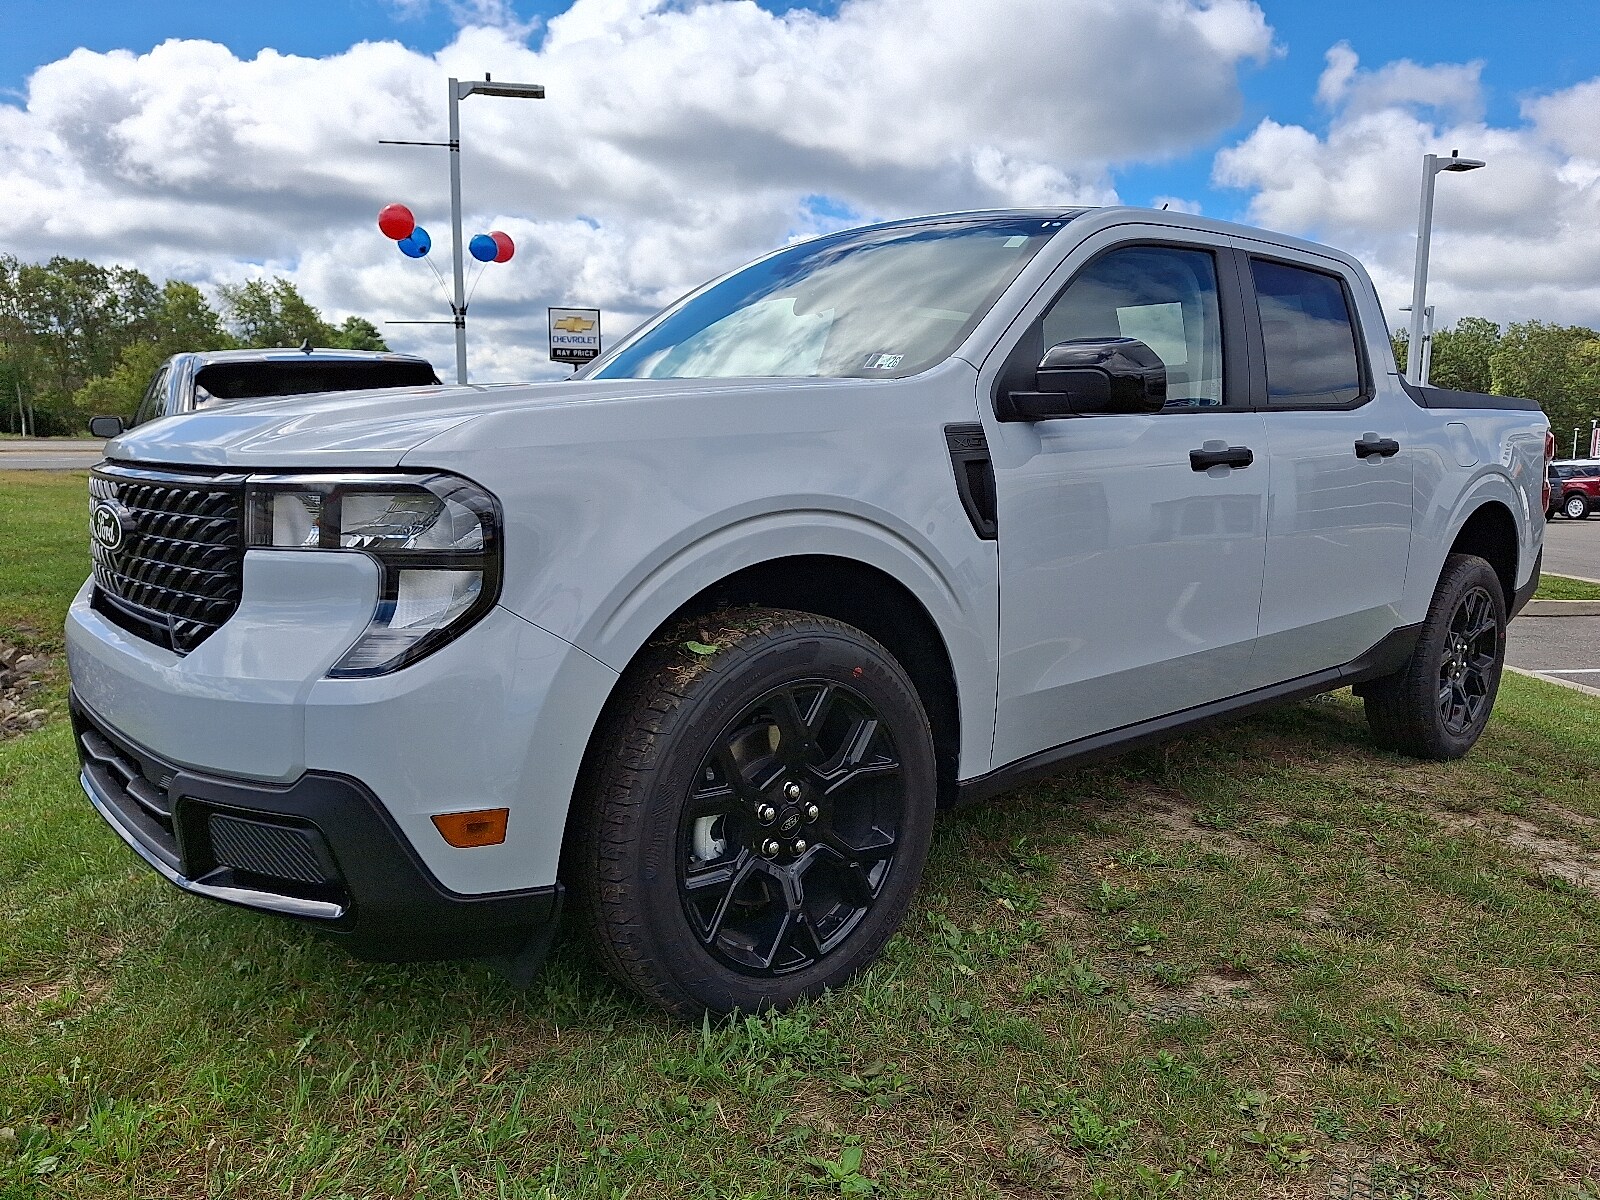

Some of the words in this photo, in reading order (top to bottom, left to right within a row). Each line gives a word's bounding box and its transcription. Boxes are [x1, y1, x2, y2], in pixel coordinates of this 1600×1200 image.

[552, 335, 597, 344] CHEVROLET
[556, 349, 571, 357] RAY
[96, 509, 115, 543] Ford
